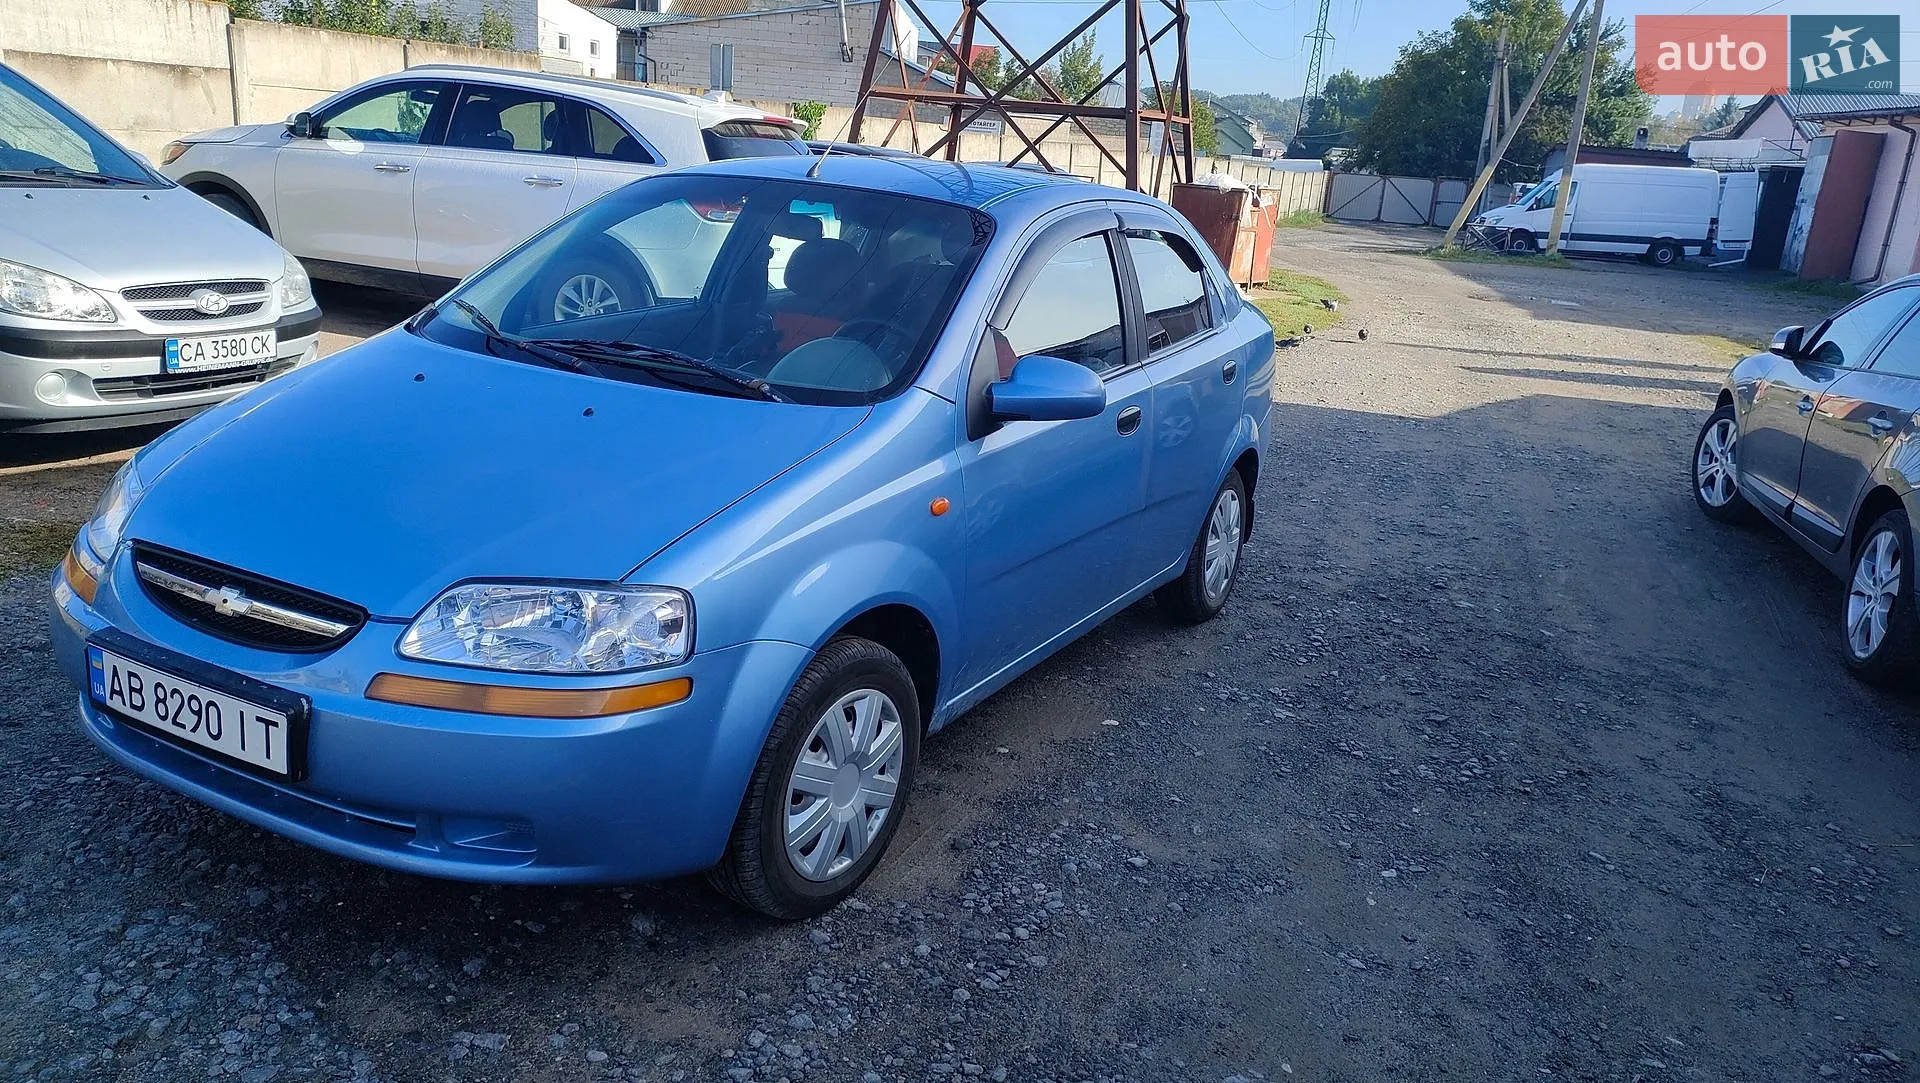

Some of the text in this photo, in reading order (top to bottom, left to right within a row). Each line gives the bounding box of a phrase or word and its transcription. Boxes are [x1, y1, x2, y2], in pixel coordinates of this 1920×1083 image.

[180, 334, 271, 362] CA 3580 CK
[169, 357, 179, 365] UA
[94, 681, 105, 697] UA
[109, 664, 279, 760] AB 8290 IT
